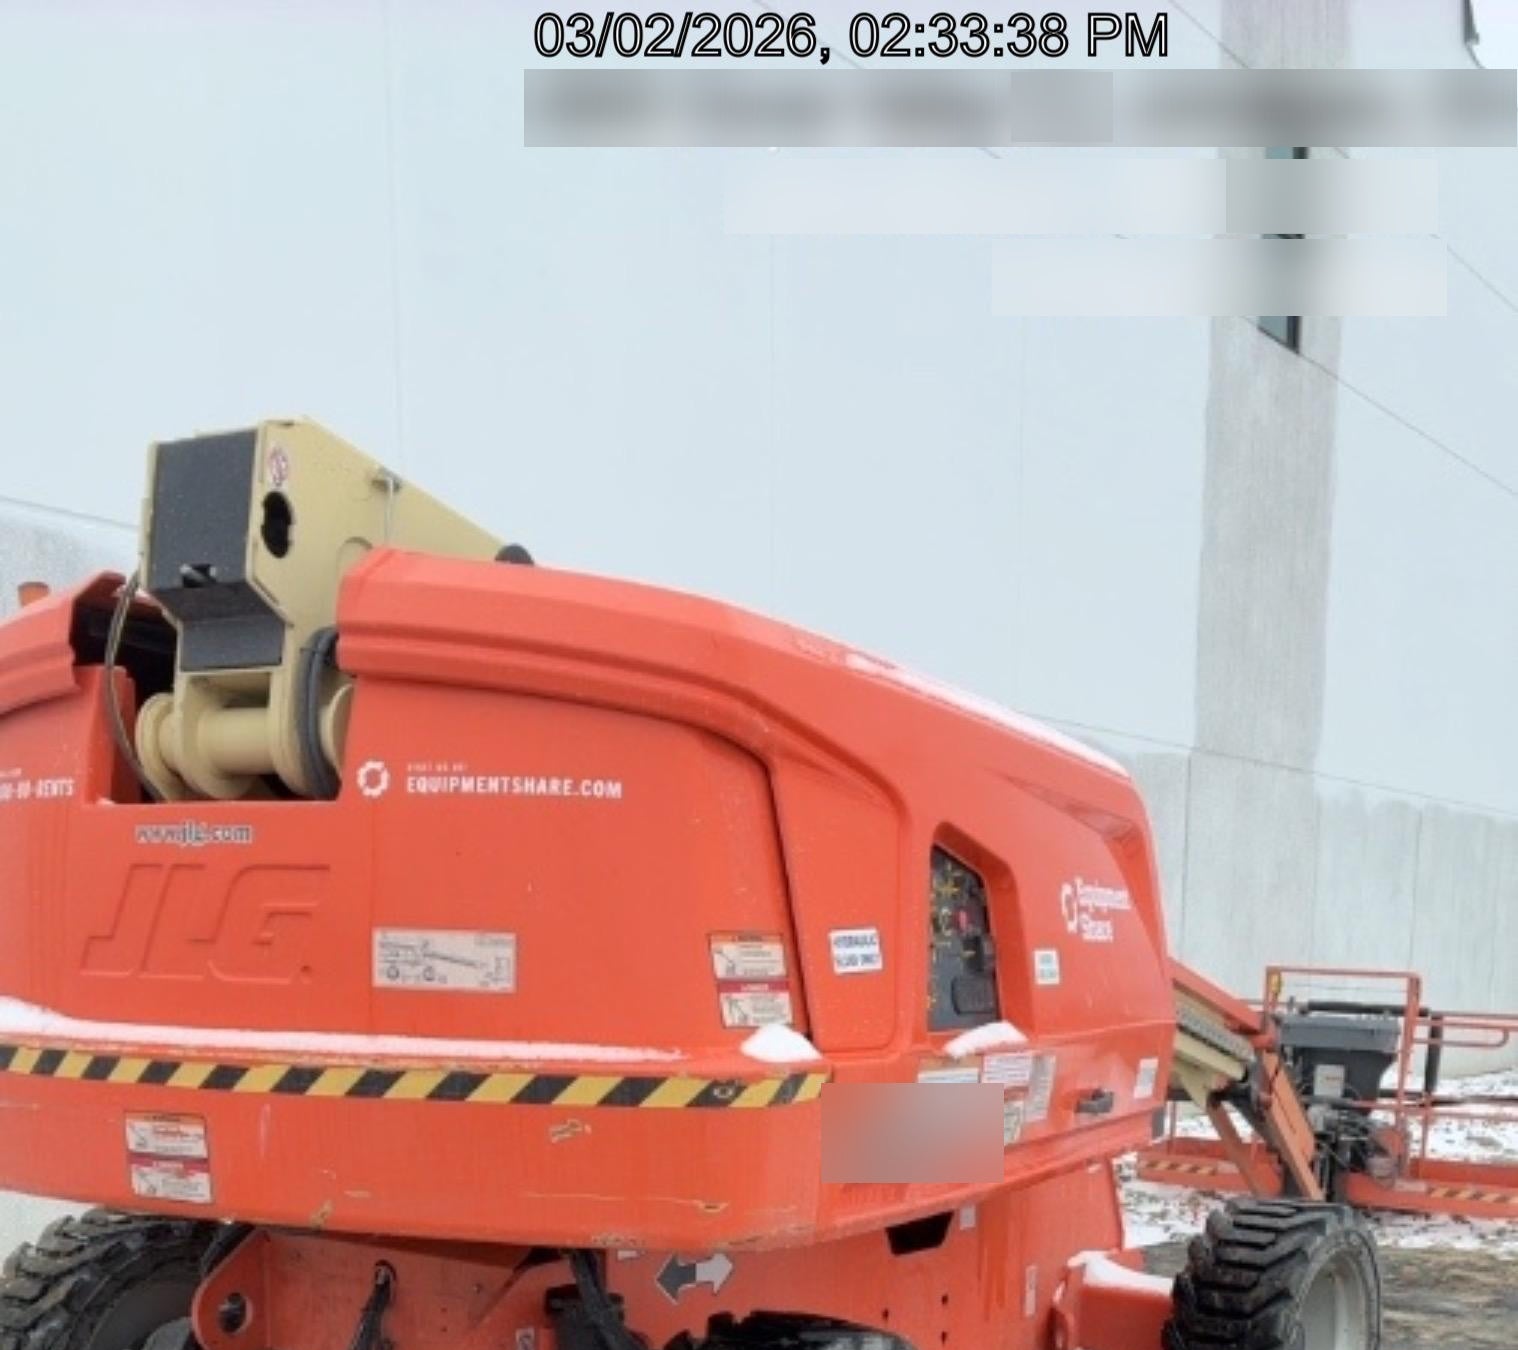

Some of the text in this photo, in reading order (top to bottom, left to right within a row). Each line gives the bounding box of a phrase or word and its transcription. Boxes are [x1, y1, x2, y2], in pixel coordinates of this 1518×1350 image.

[406, 776, 622, 798] EQUIPMENTSHARE.COM
[135, 820, 252, 848] www.jlg.com
[80, 863, 331, 986] JLG
